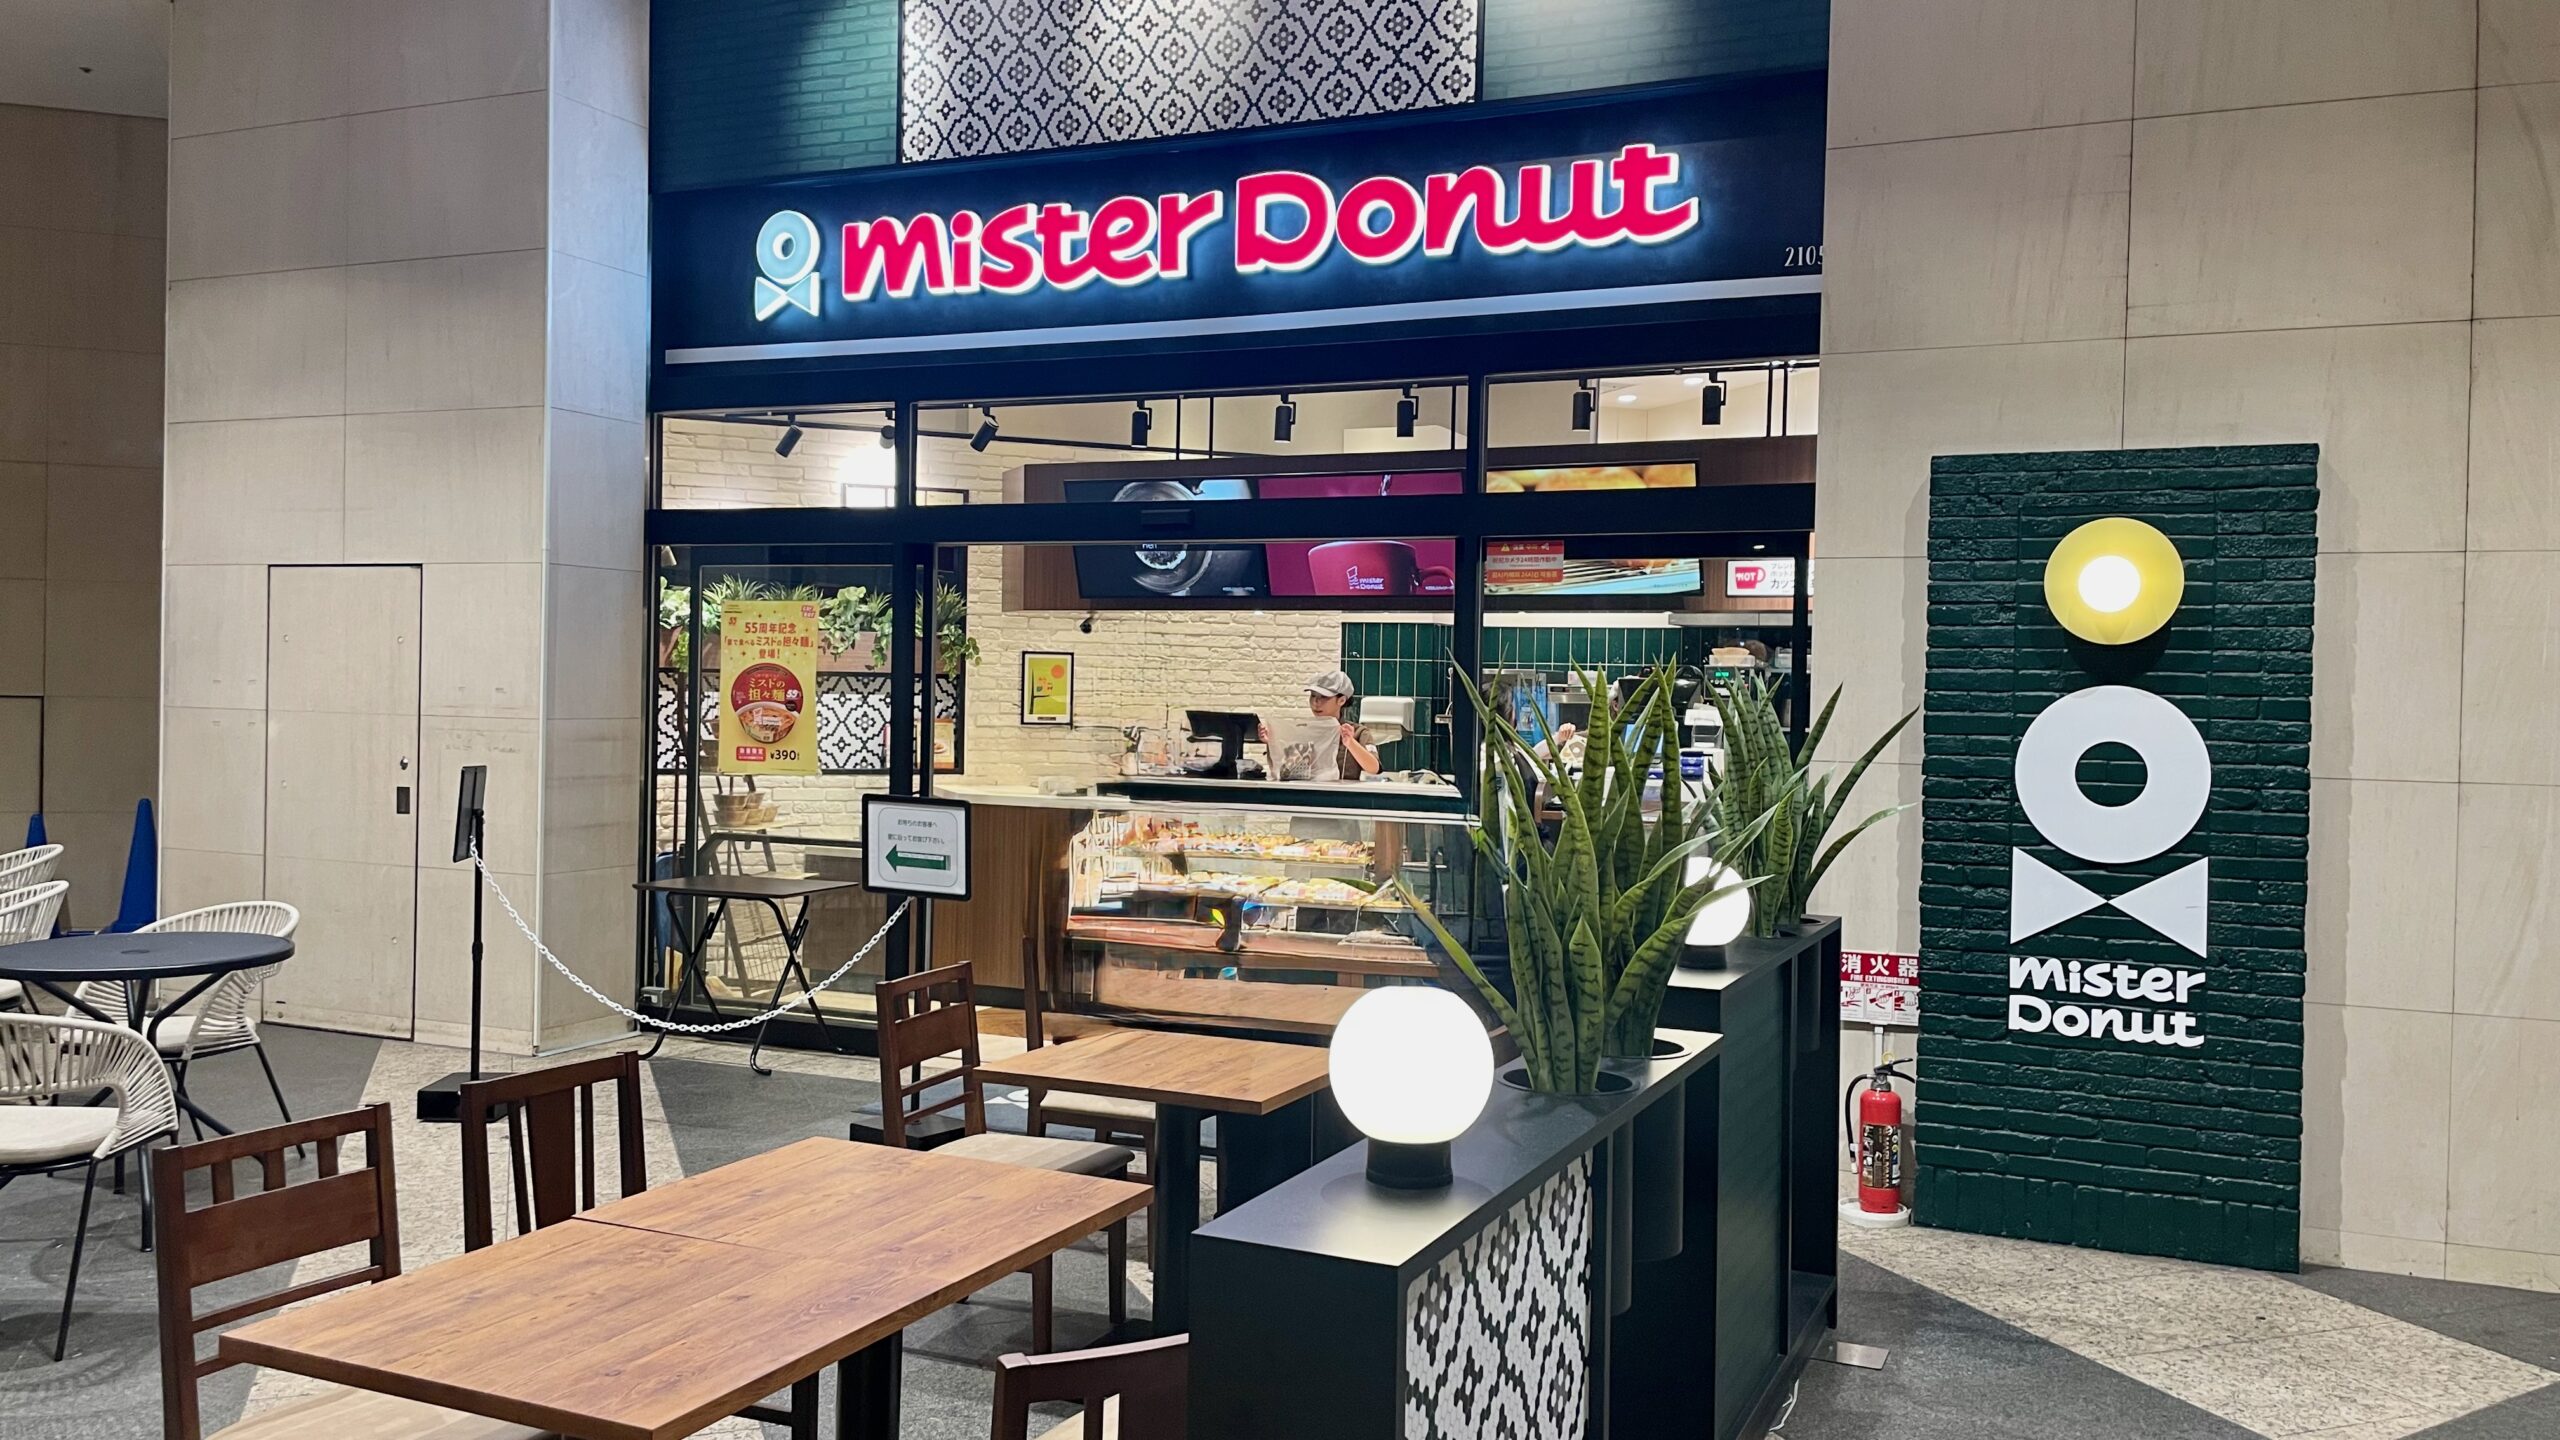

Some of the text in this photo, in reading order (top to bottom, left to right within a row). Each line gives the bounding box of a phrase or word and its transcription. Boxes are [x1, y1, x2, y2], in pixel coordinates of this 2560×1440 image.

[1235, 142, 1700, 273] Donut
[743, 622, 797, 635] 55周年記念
[1840, 953, 1919, 978] 消火器
[1849, 973, 1910, 985] FIRE EXTINGUISHER
[2008, 994, 2205, 1048] Donut
